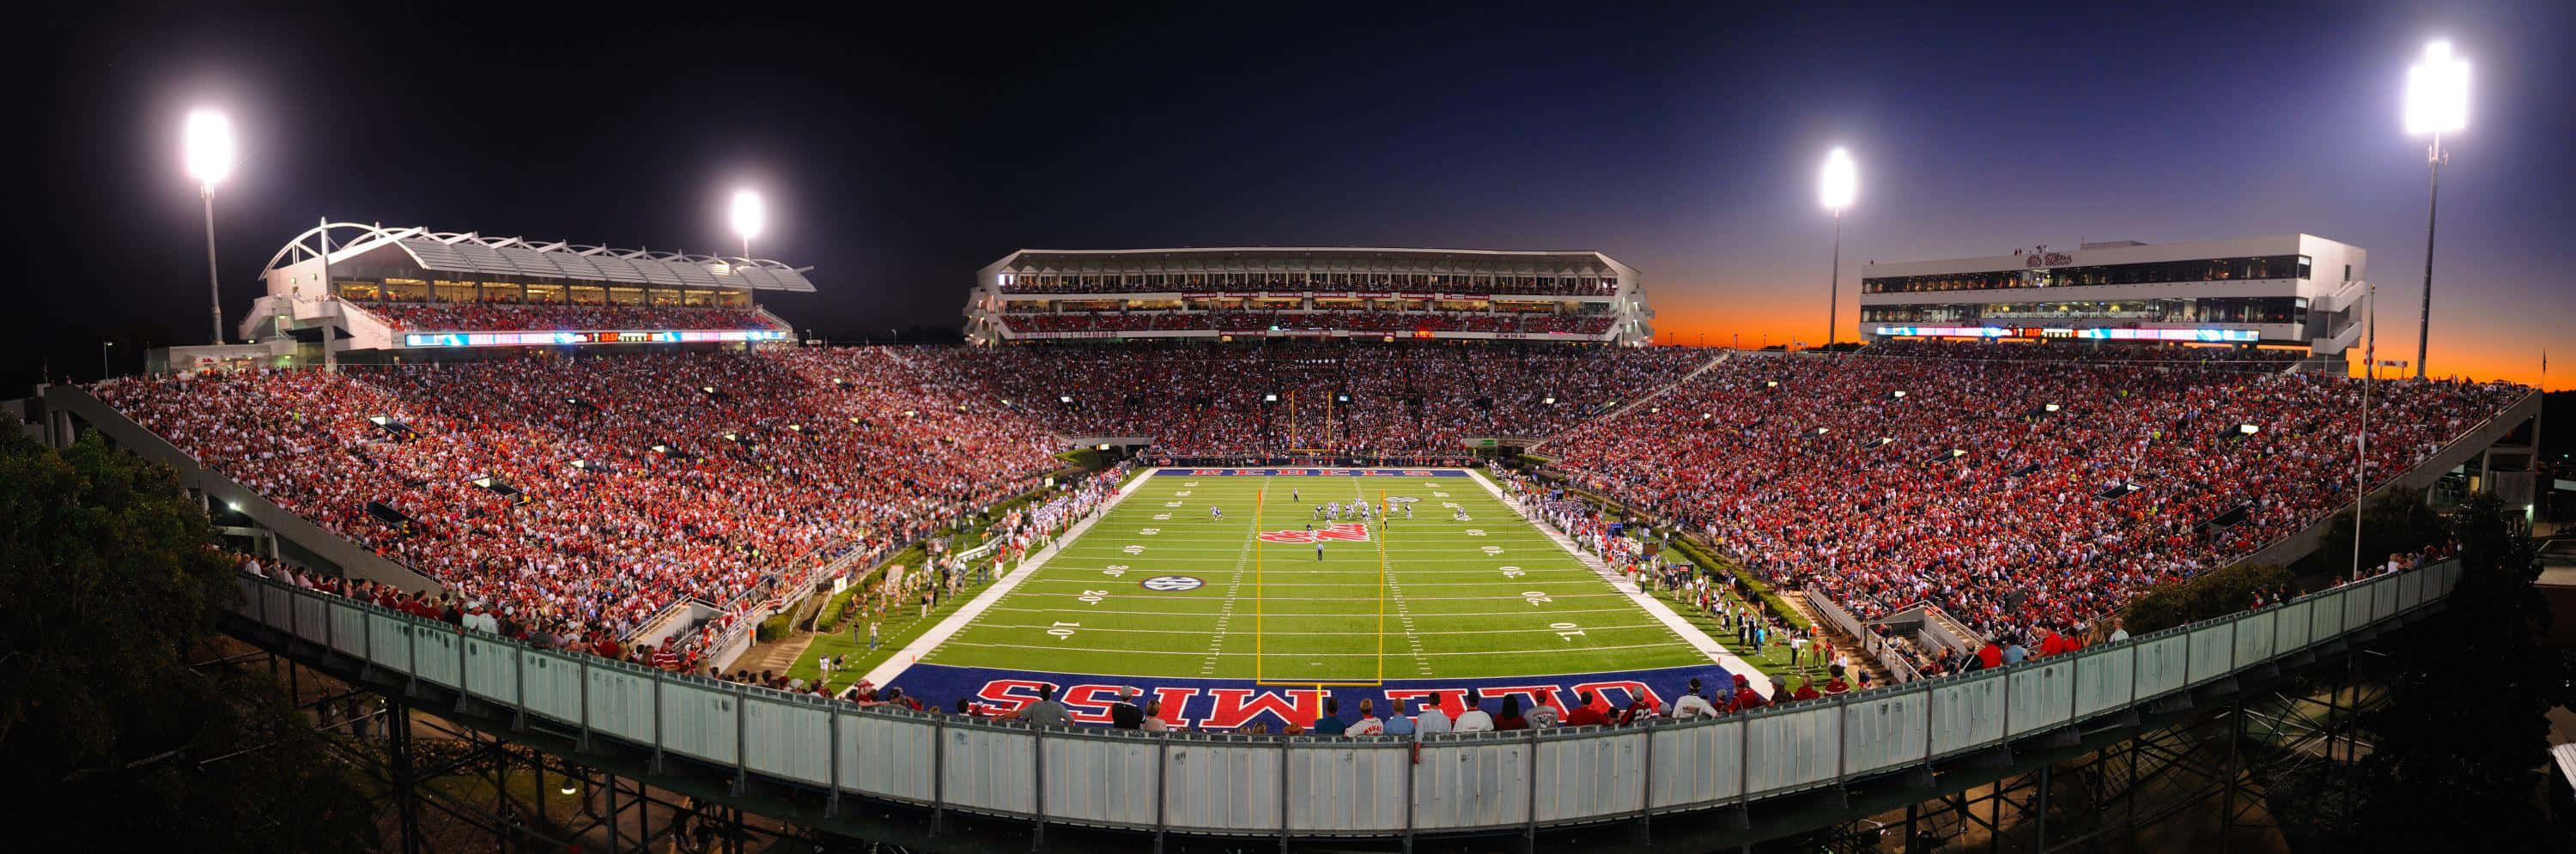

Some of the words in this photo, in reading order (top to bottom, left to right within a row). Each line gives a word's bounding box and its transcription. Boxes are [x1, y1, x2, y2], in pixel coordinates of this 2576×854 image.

[2045, 253, 2072, 266] Miss
[1103, 565, 1130, 575] 30
[1499, 566, 1526, 576] 30
[1078, 590, 1109, 602] 20
[1522, 591, 1552, 603] 20
[1047, 621, 1080, 635] 10
[1550, 622, 1586, 636] 10
[969, 679, 1331, 730] MISS
[1383, 681, 1664, 724] OLE
[1635, 708, 1652, 722] 22
